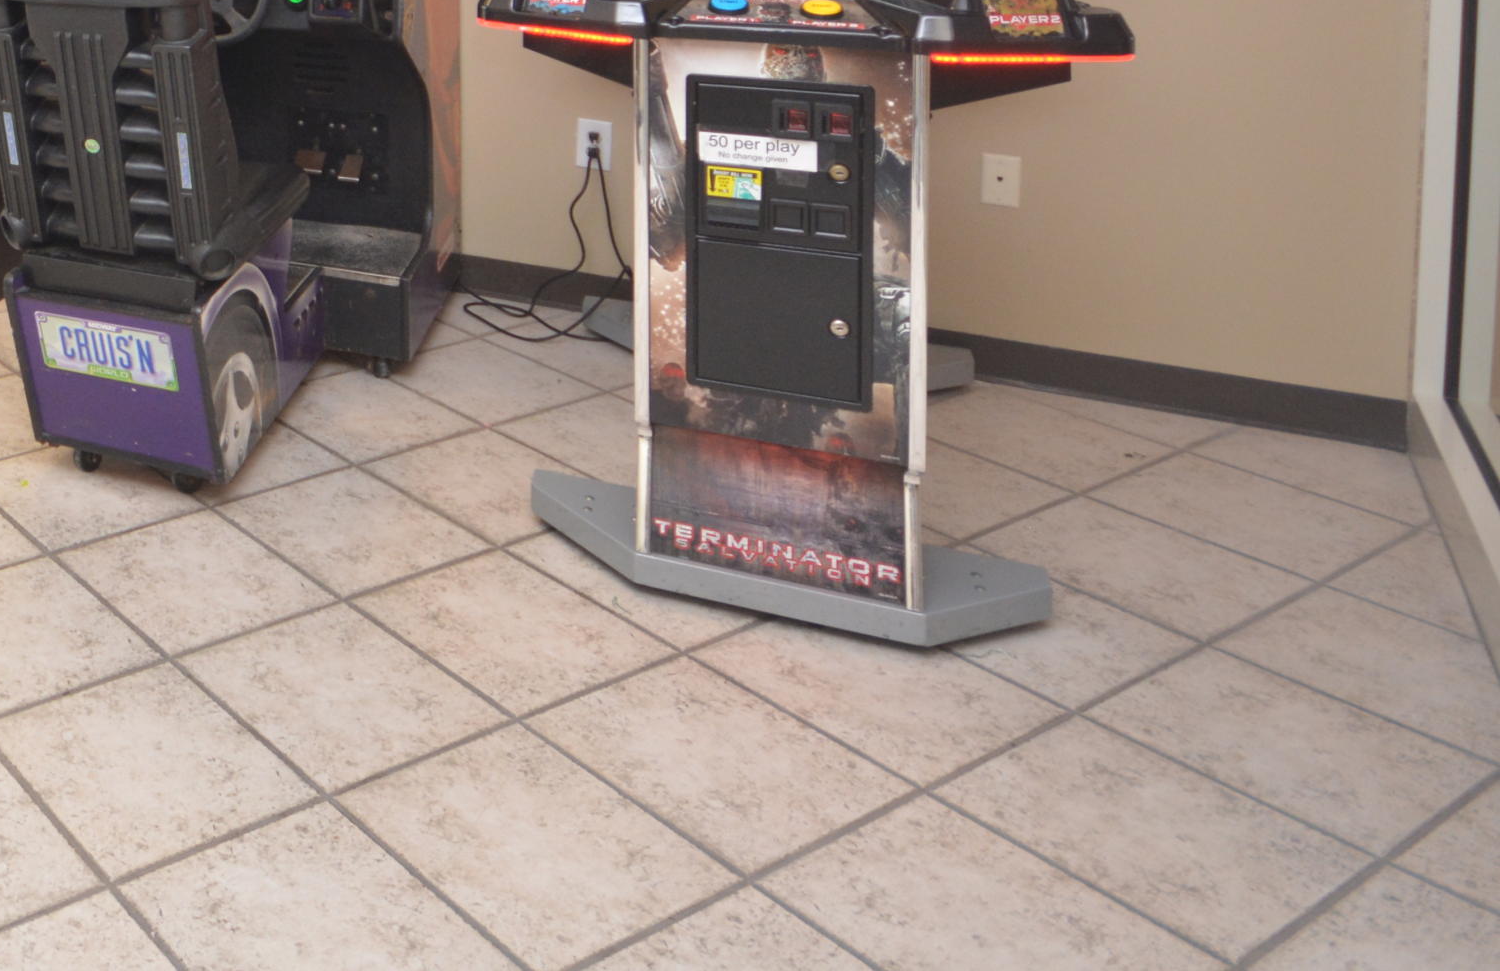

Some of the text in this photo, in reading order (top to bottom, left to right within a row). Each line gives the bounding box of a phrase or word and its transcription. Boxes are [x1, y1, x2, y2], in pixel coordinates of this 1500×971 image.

[988, 14, 1061, 24] PLAYER 2
[732, 153, 762, 162] change
[734, 139, 760, 151] per
[765, 140, 800, 157] play
[59, 325, 156, 375] CRUIS'N
[654, 518, 901, 582] TERMINATOR
[674, 537, 871, 587] SALVATION
